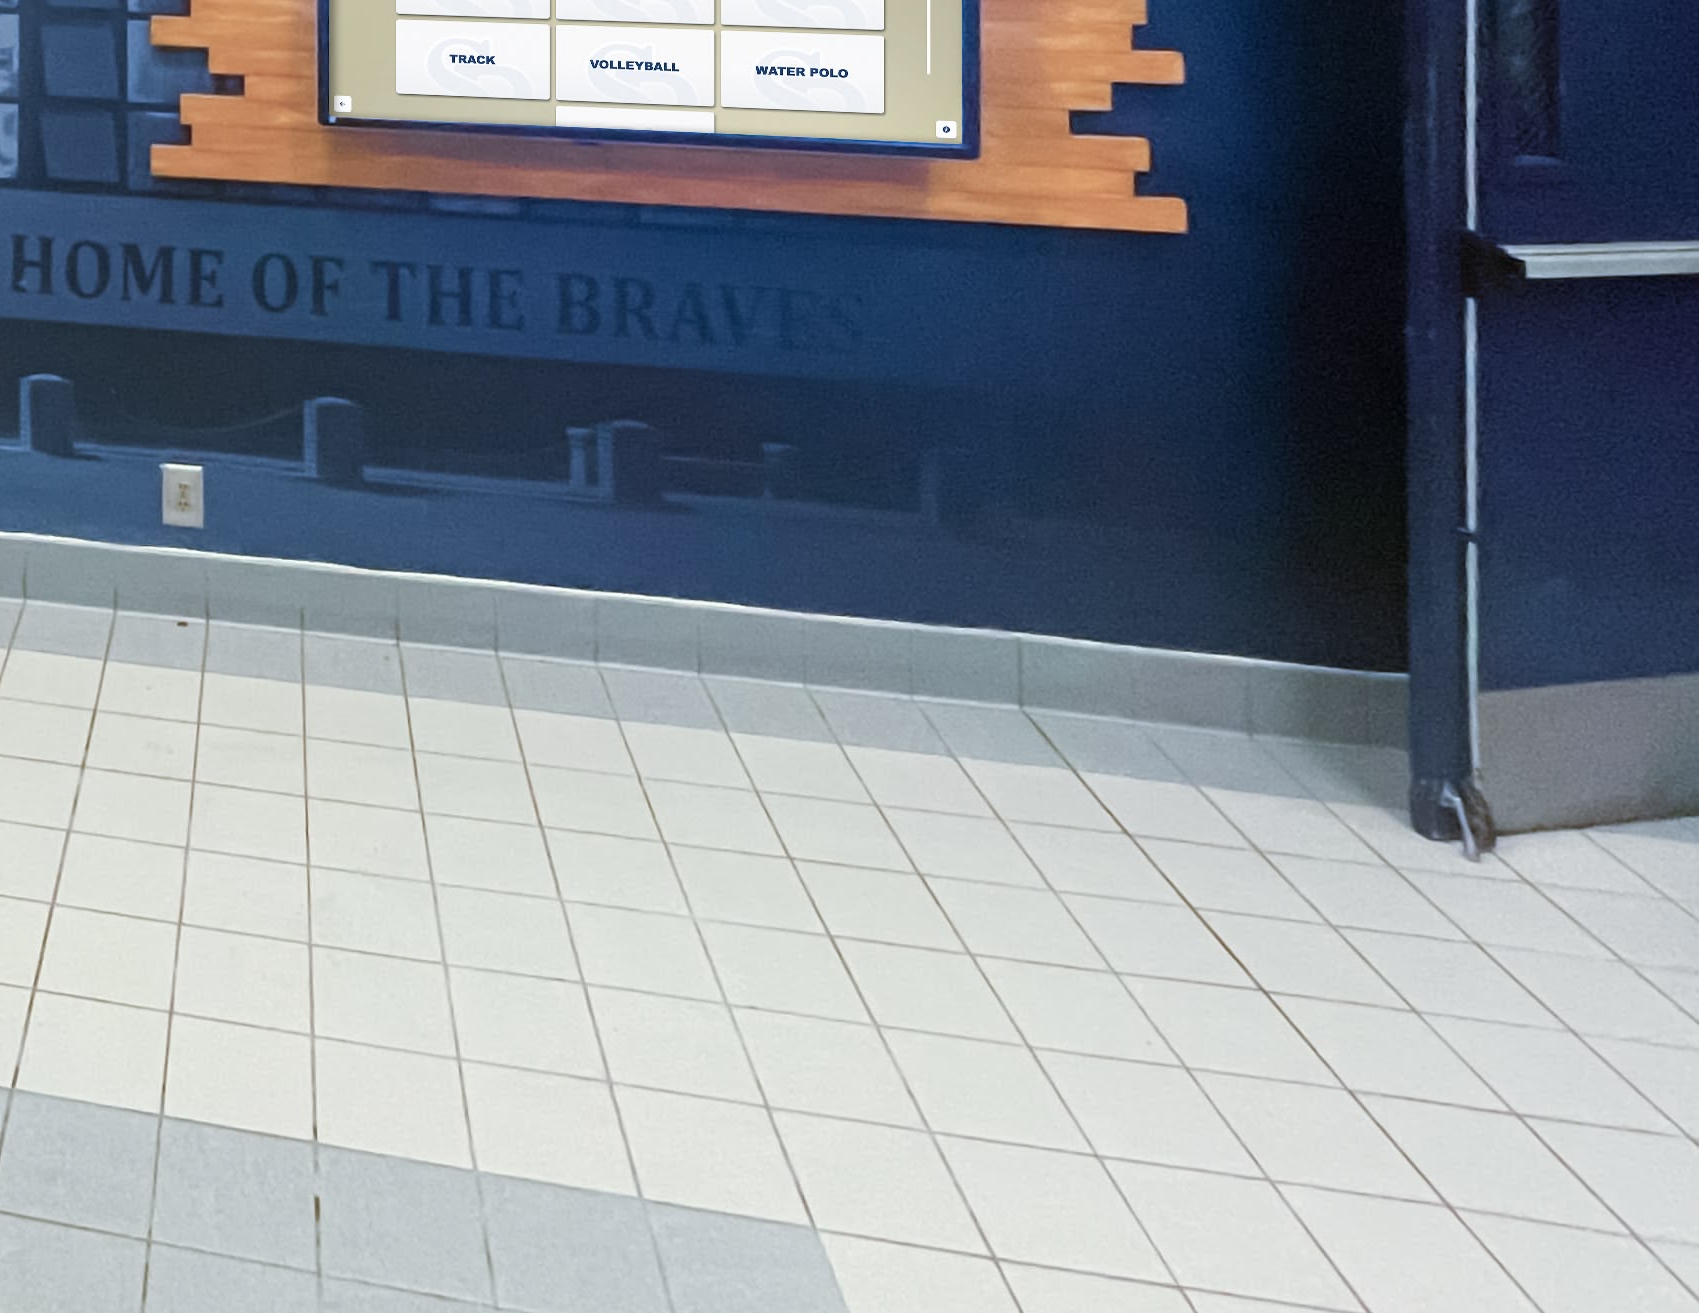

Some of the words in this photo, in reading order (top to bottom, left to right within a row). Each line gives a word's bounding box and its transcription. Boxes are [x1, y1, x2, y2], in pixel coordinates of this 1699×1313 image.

[449, 53, 495, 65] TRACK
[590, 59, 679, 71] VOLLEYBALL
[756, 65, 805, 77] WATER
[809, 67, 849, 79] POLO
[9, 233, 225, 310] HOME
[251, 253, 345, 318] OF
[371, 258, 524, 333] THE
